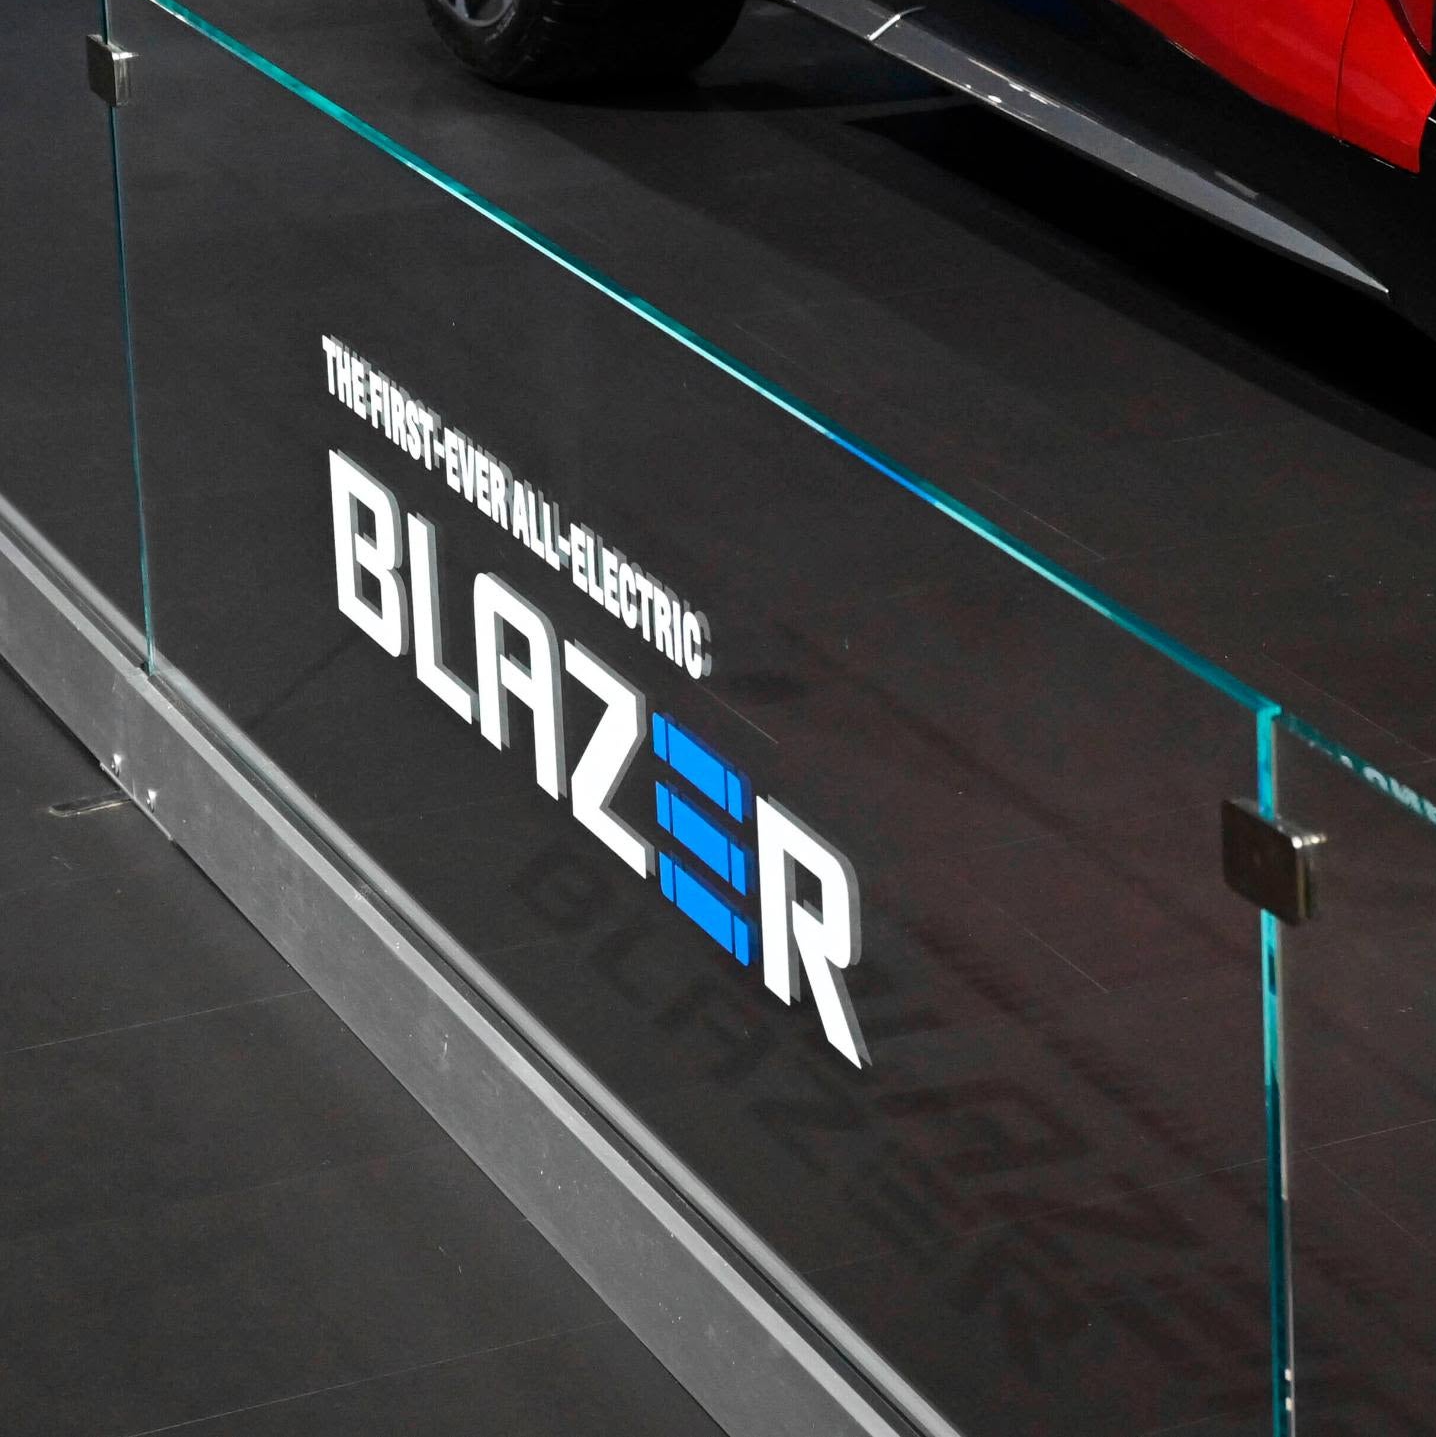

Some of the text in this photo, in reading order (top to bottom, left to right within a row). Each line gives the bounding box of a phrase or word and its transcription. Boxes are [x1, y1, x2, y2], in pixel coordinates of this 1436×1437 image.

[322, 335, 703, 680] THE FIRST-EVER ALL-ELECTRIC
[329, 450, 863, 1070] BLAZER
